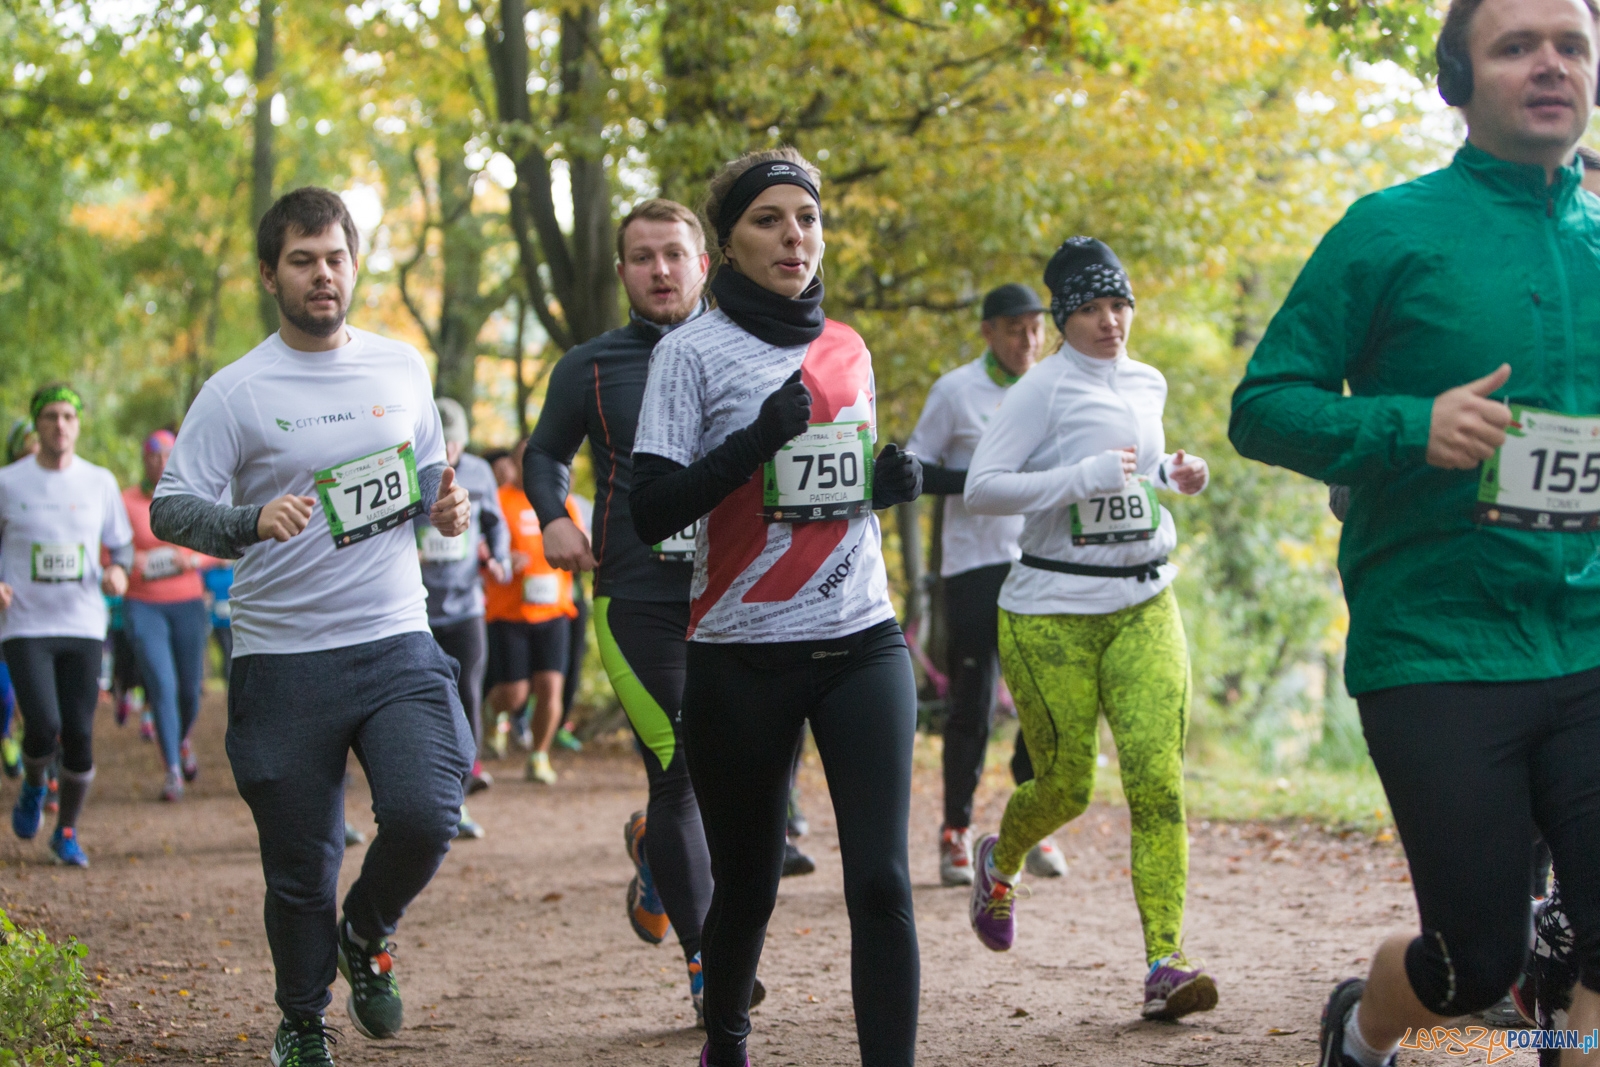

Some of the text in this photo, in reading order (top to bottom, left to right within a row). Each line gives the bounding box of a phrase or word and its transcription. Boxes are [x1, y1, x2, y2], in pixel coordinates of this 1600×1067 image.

[668, 394, 678, 421] zrobić,
[792, 451, 858, 490] 750
[1529, 447, 1600, 494] 155
[343, 470, 402, 515] 728
[809, 492, 848, 503] PATRYCJA
[366, 503, 397, 522] MATEUSZ
[1088, 495, 1144, 523] 788
[750, 604, 803, 624] marnowanie
